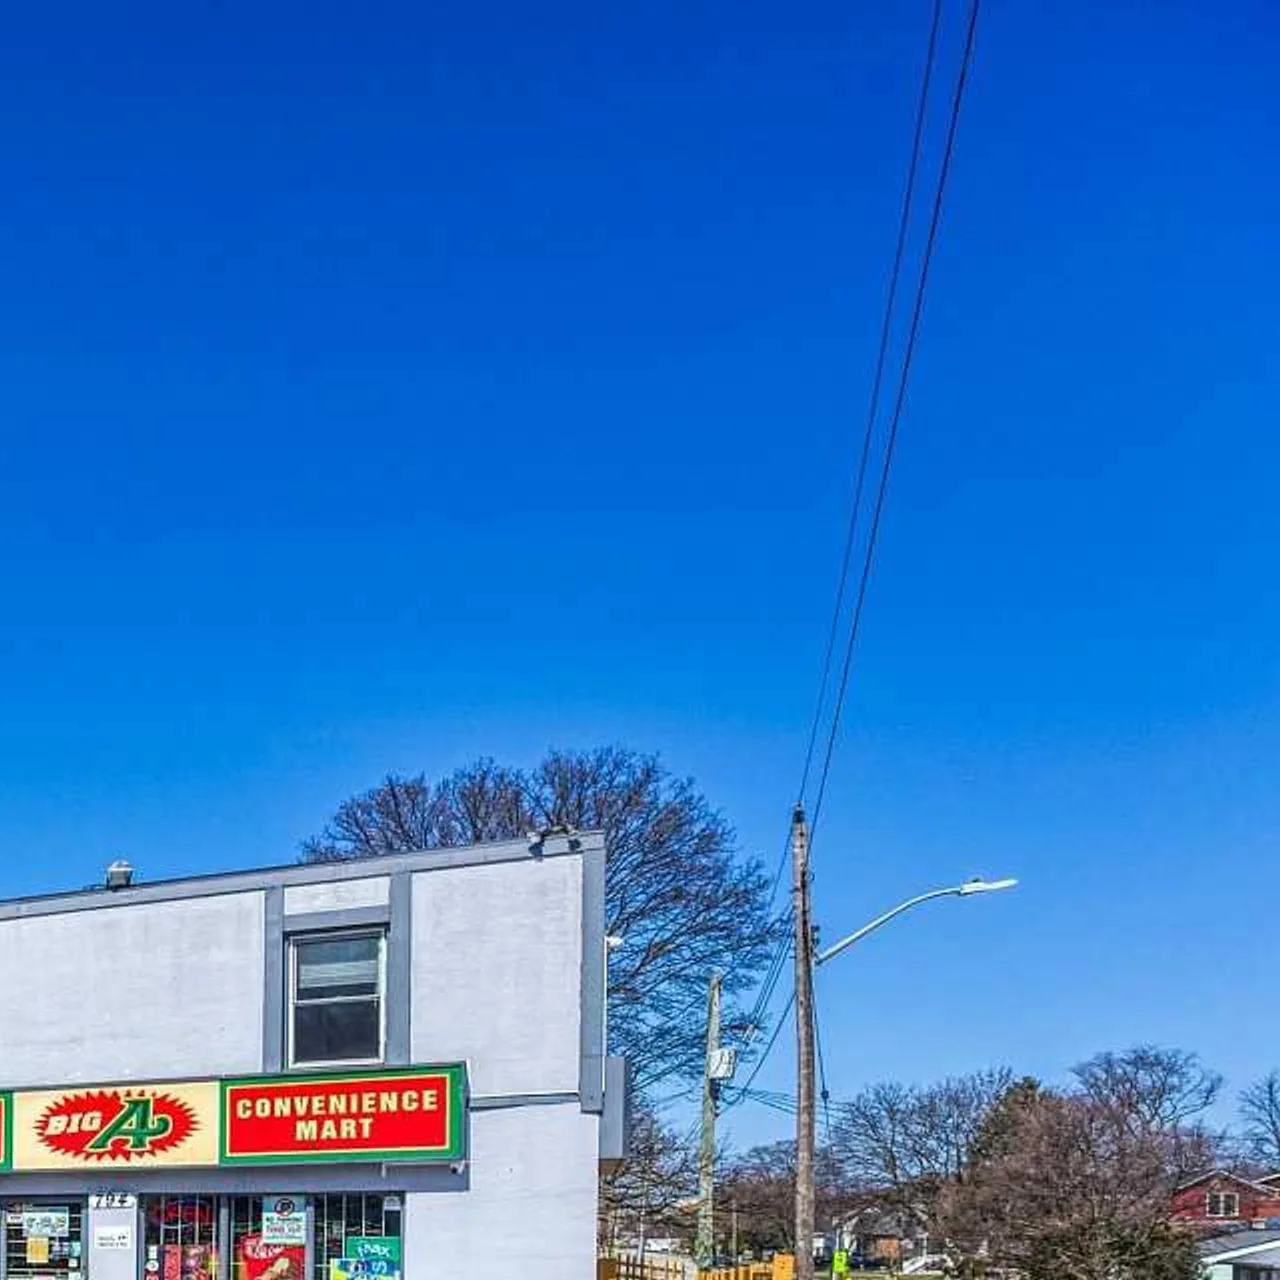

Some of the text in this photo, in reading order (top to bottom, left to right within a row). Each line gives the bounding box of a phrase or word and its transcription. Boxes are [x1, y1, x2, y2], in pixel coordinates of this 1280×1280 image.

[236, 1089, 439, 1119] CONVENIENCE
[44, 1097, 174, 1151] BIG A
[295, 1118, 374, 1141] MART
